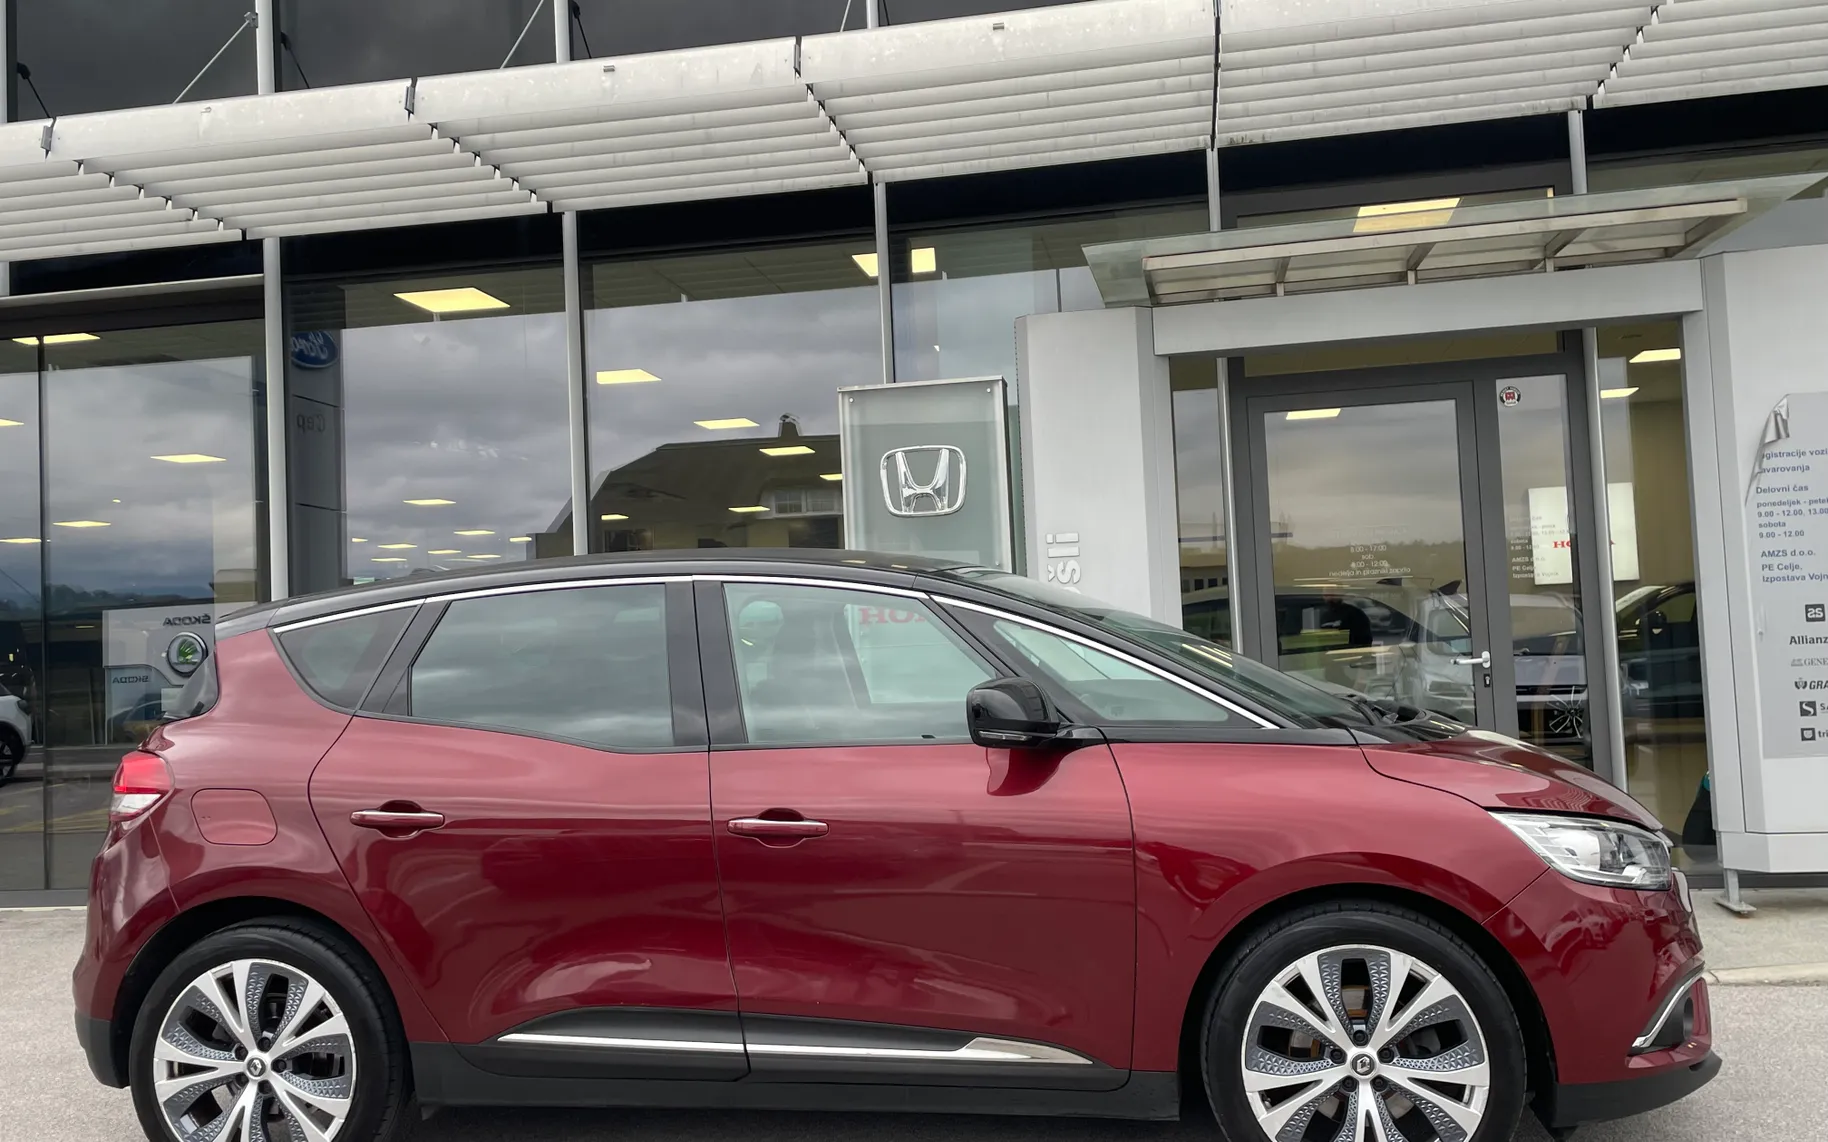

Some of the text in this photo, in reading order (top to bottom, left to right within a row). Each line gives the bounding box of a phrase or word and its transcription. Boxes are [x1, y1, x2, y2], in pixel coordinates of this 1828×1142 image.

[1762, 449, 1807, 460] gistracije
[1761, 464, 1810, 473] avarovanja
[1756, 484, 1809, 494] Delovni čas
[1756, 499, 1801, 508] ponedeljek
[1757, 510, 1775, 518] 9.00
[1758, 531, 1776, 539] 9.00
[1783, 530, 1805, 538] 12.00
[1761, 549, 1816, 558] AMZS d.o.o.
[1045, 532, 1081, 594] šli
[1761, 563, 1775, 571] PE
[1762, 574, 1806, 583] Izpostava
[1789, 635, 1828, 645] Allianz
